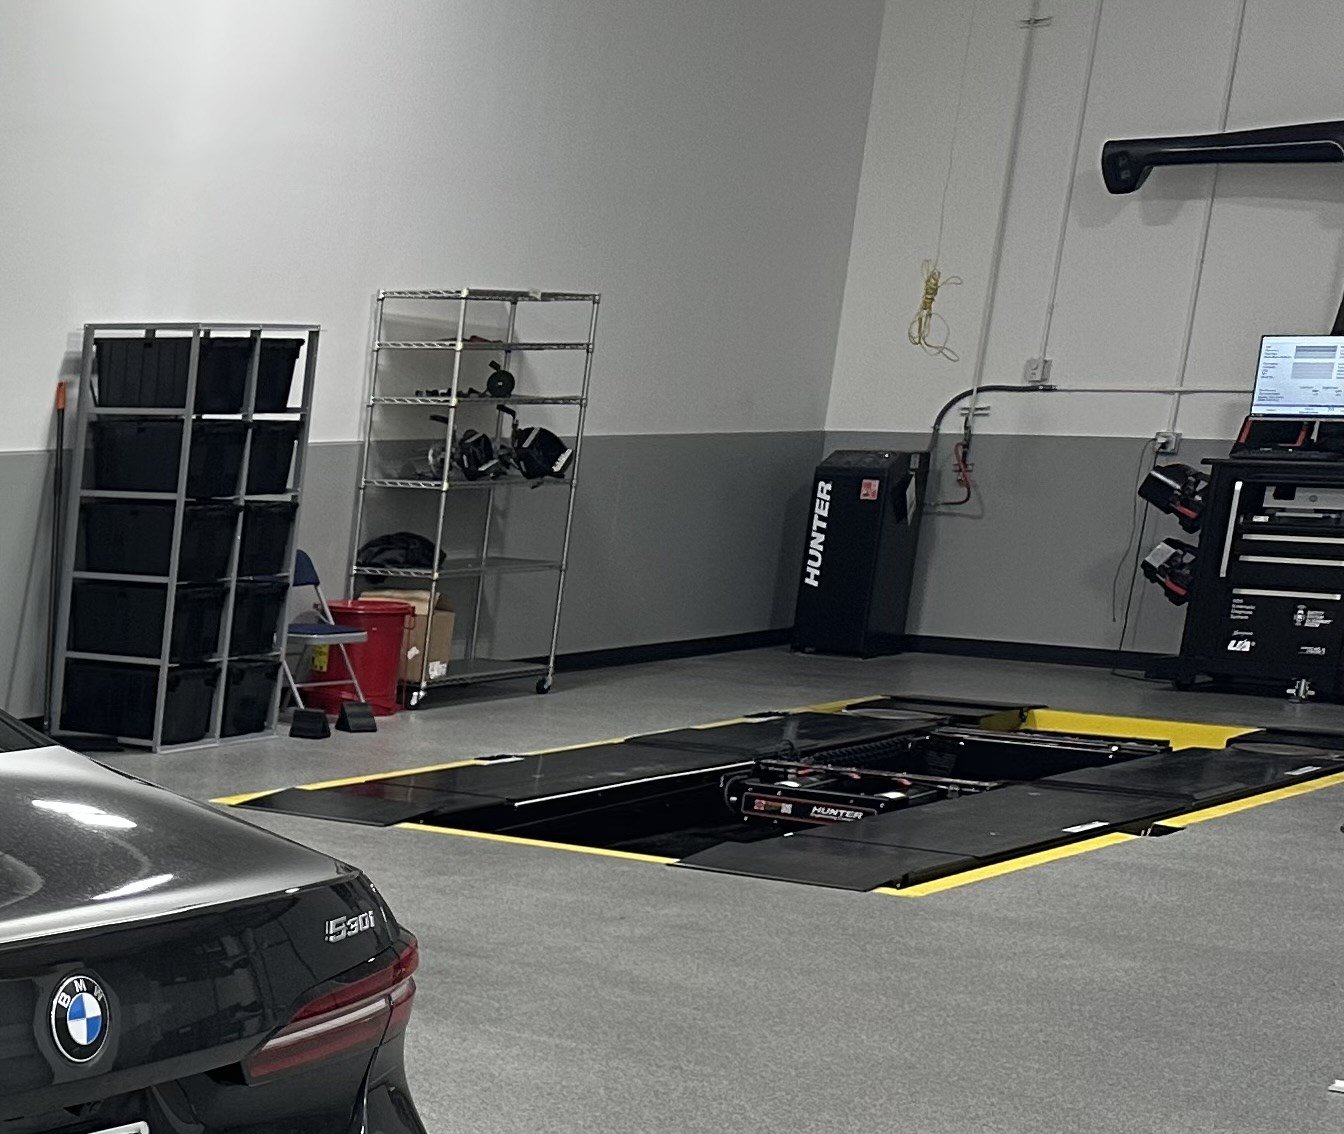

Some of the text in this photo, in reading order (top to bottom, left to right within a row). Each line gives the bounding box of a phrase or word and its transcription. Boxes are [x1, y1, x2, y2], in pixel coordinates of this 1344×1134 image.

[804, 480, 832, 588] HUNTER
[811, 805, 864, 820] HUNTER
[57, 978, 104, 1009] BMW
